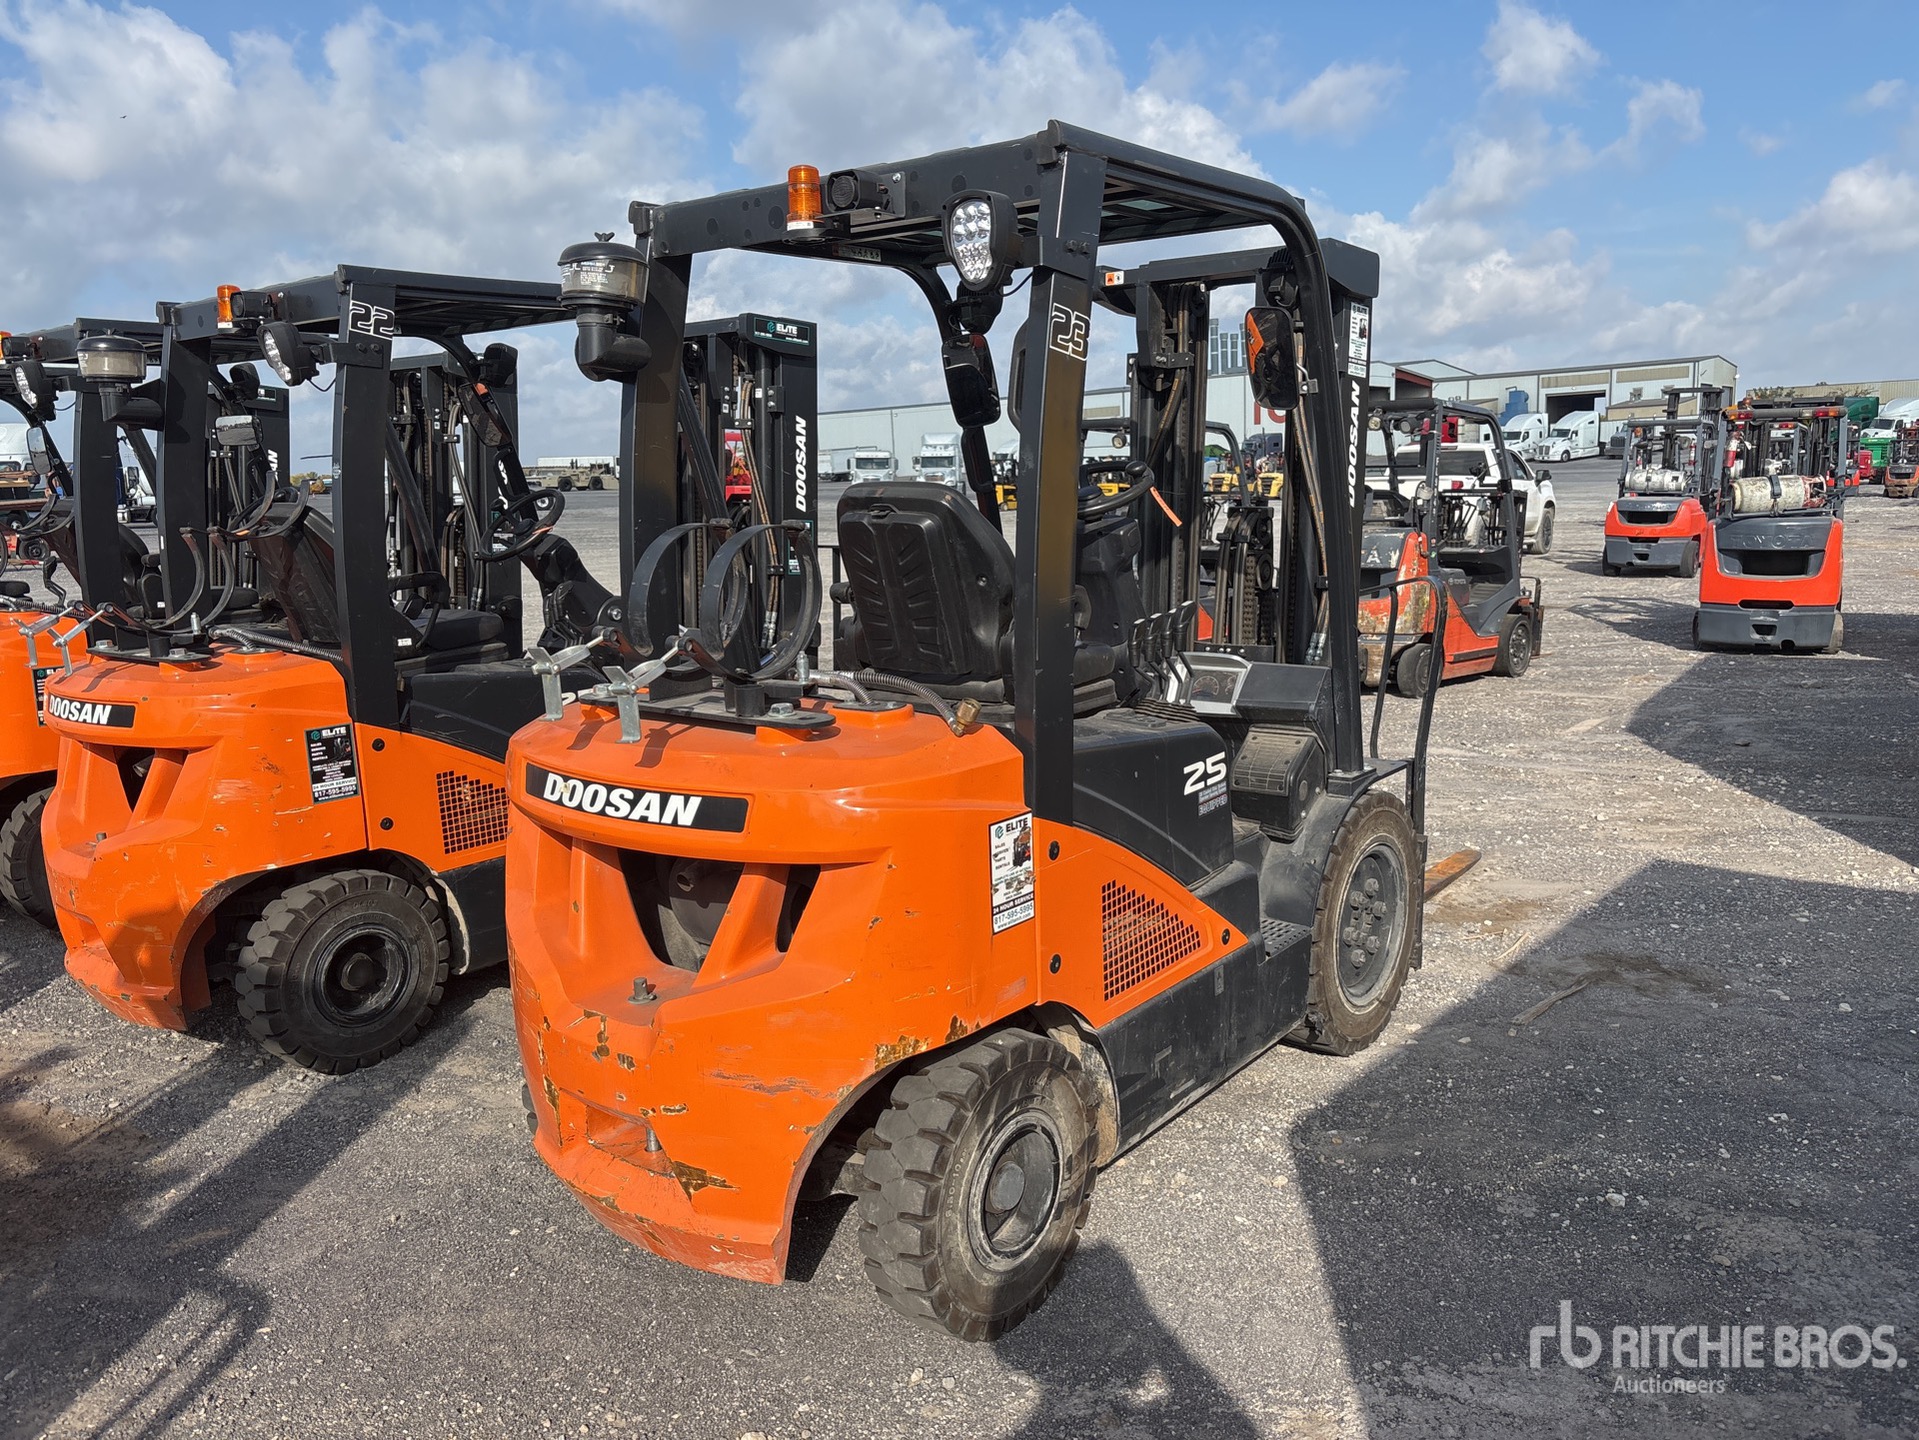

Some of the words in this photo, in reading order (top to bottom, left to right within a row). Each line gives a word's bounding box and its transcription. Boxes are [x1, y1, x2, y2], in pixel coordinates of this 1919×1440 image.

[349, 300, 395, 341] 22
[776, 323, 798, 335] ELITE
[1050, 302, 1091, 362] 23
[795, 415, 807, 513] DOOSAN
[48, 694, 112, 725] DOOSAN
[321, 726, 346, 737] ELITE
[1183, 751, 1227, 796] 25
[543, 772, 702, 826] DOOSAN
[1005, 817, 1029, 833] ELITE
